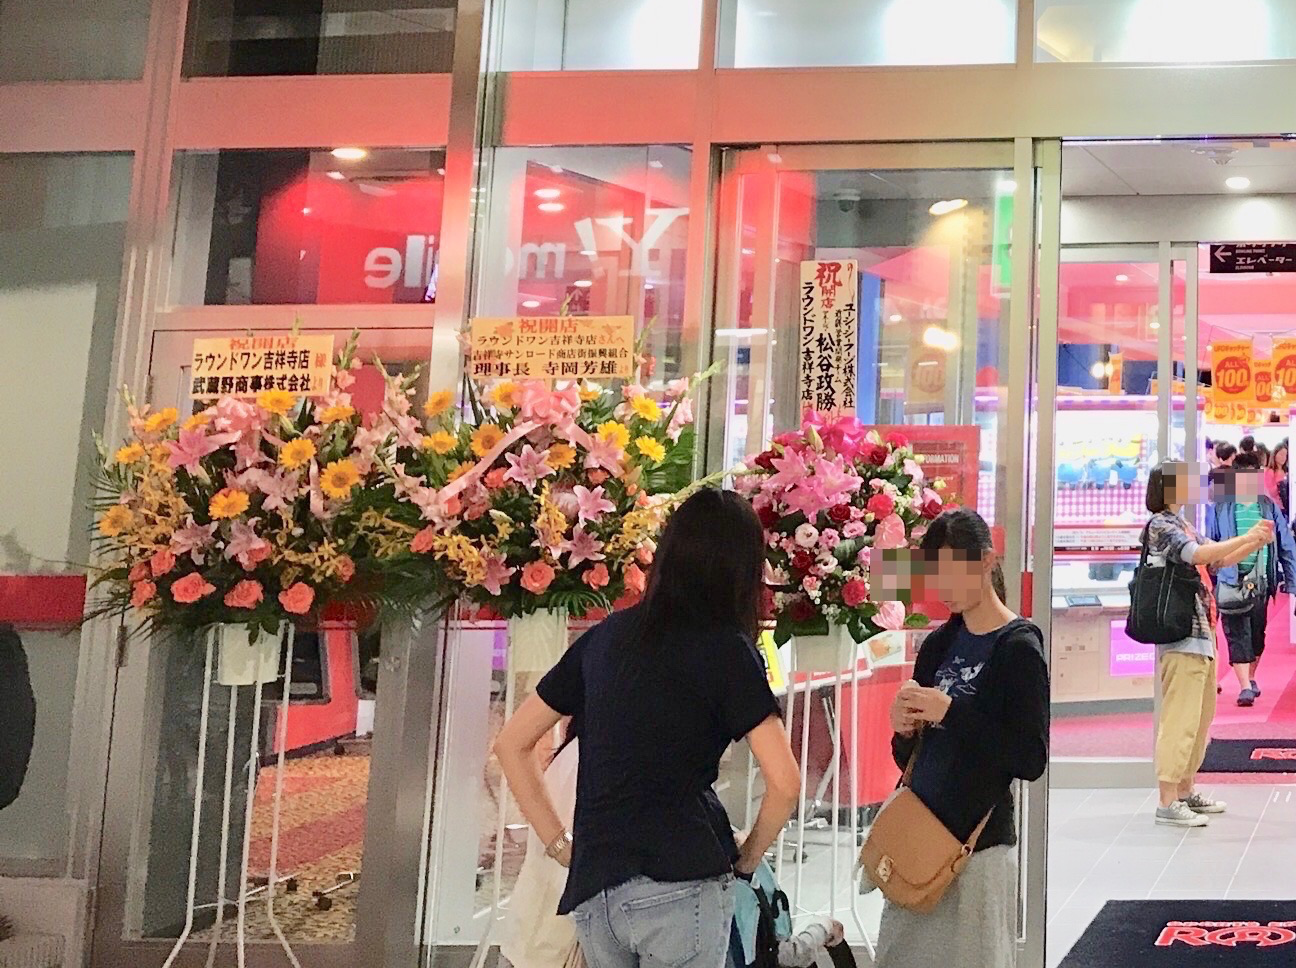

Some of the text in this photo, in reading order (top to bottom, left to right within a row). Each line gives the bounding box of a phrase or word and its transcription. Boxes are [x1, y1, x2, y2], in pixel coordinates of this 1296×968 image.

[518, 317, 578, 334] 祝開店
[801, 281, 816, 402] ラウンドワン吉祥寺店
[194, 349, 311, 372] ラウンドワン吉祥寺店
[473, 361, 530, 377] 理事長
[815, 332, 837, 412] 松谷政勝
[1216, 368, 1248, 388] 100
